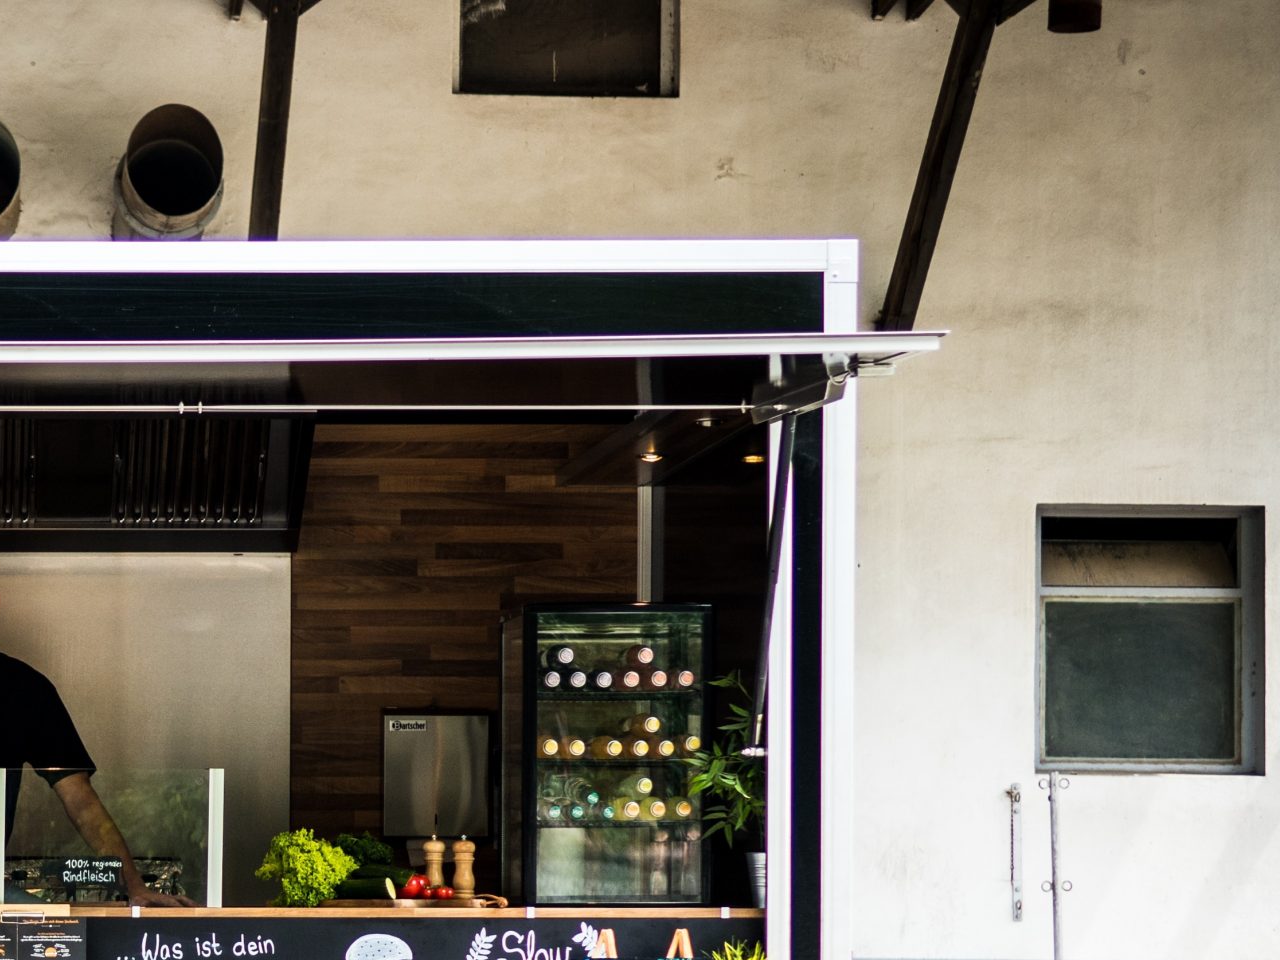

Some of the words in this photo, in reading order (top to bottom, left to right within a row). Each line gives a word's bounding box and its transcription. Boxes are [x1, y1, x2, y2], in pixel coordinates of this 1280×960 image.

[65, 859, 89, 869] 100%
[62, 869, 116, 883] Rindfleisch
[195, 932, 223, 958] ist
[232, 933, 275, 957] dein
